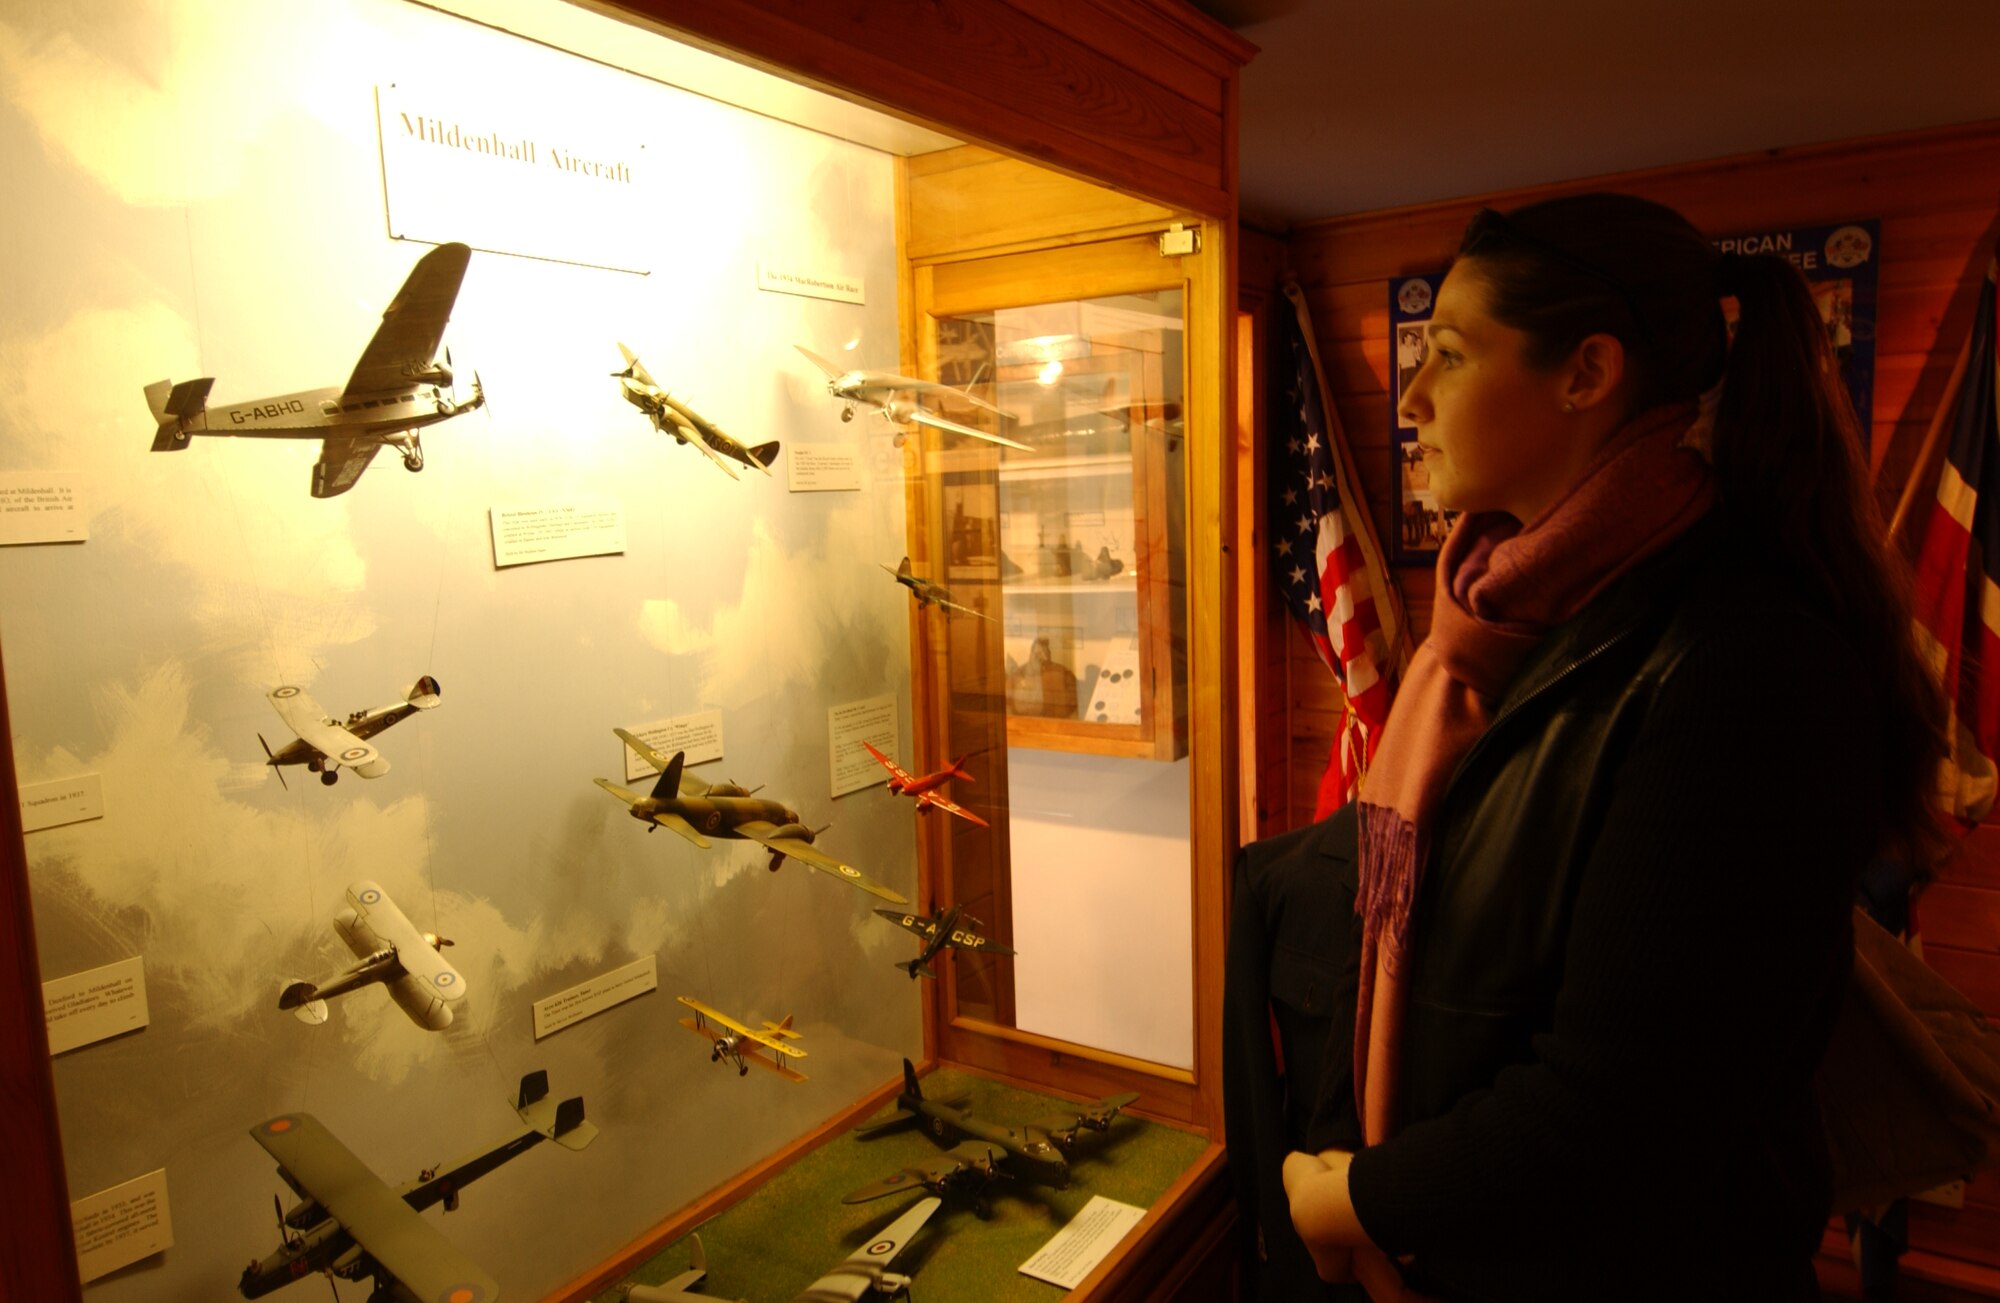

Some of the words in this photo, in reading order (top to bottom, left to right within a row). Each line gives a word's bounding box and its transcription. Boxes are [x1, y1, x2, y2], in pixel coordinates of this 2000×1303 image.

[400, 111, 536, 164] Mildenhall
[548, 147, 632, 183] Aircraft
[1783, 251, 1818, 270] EE
